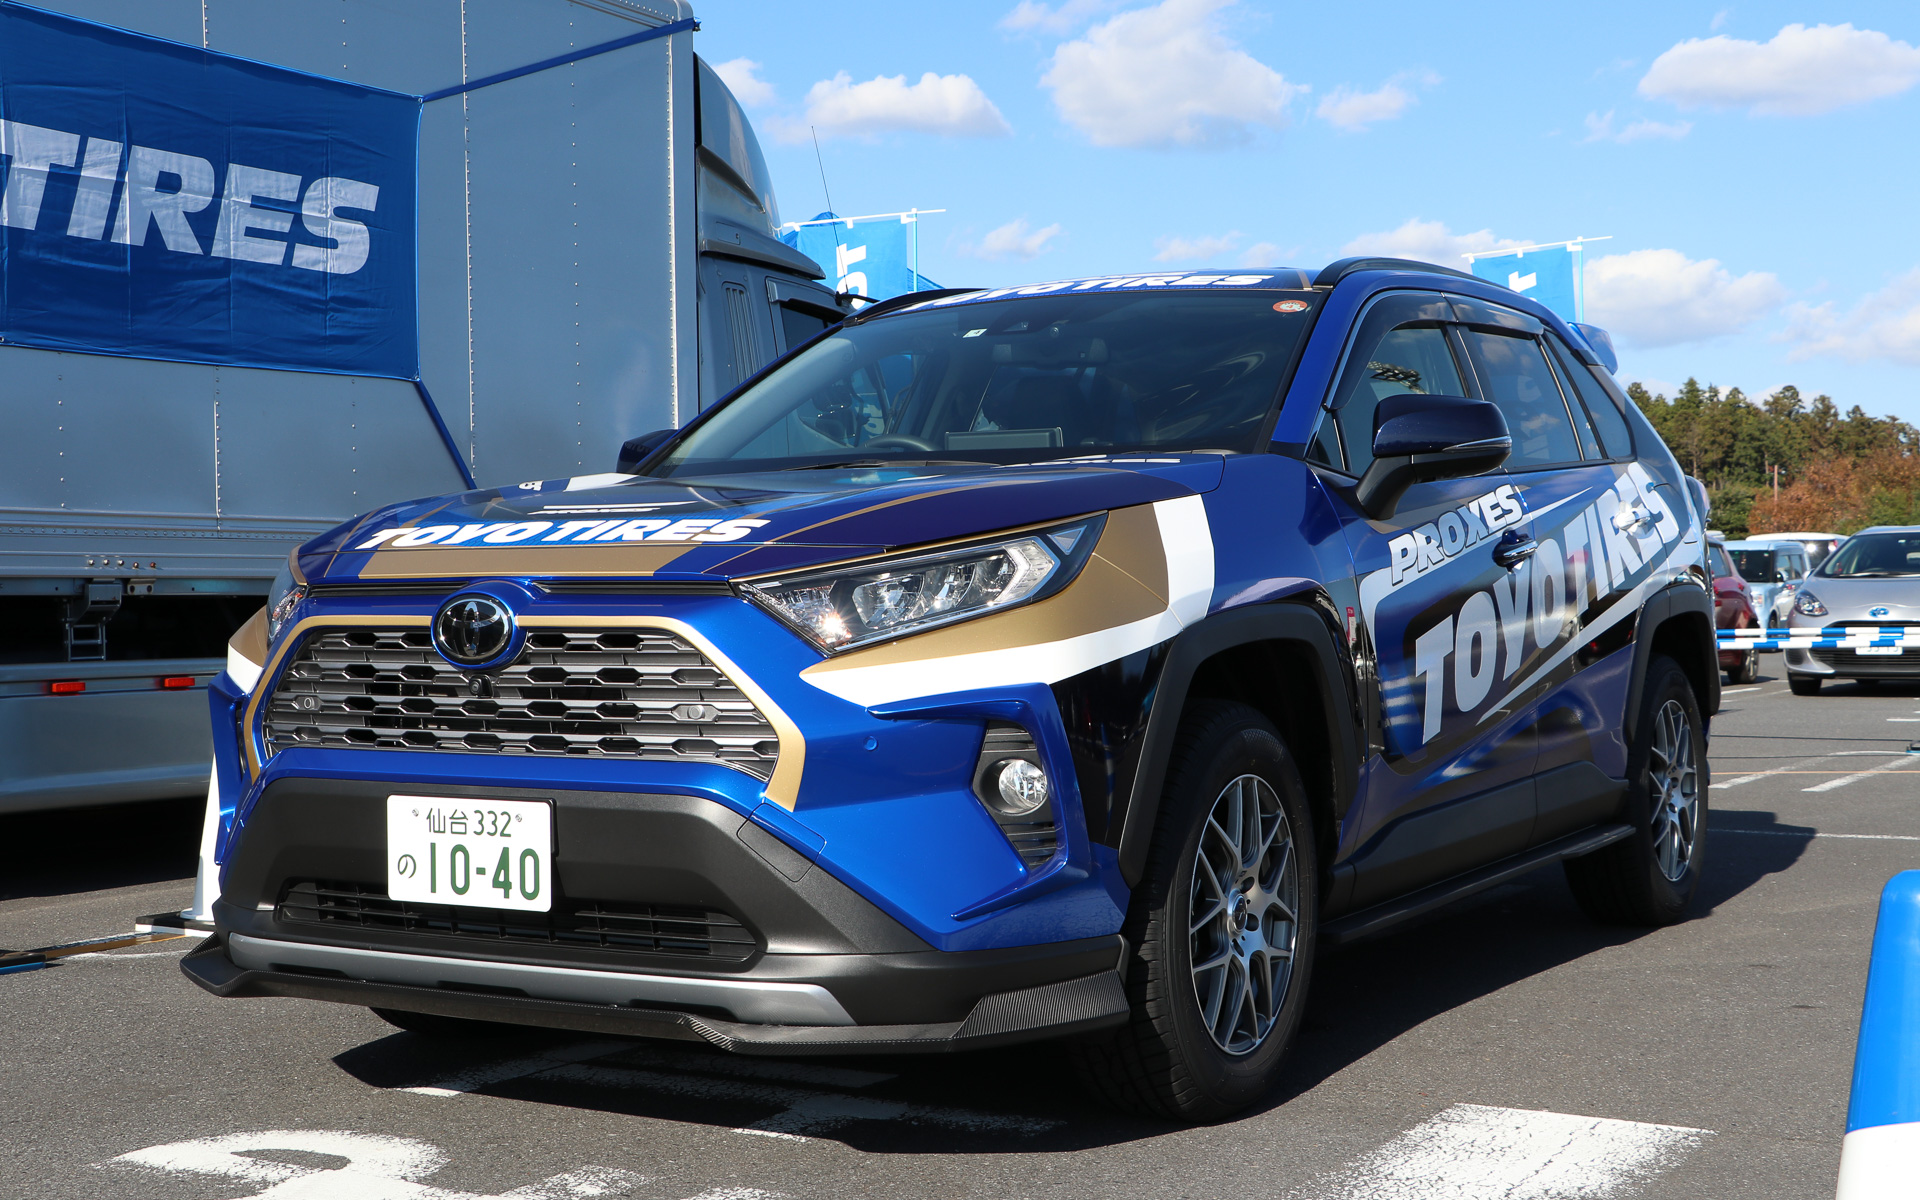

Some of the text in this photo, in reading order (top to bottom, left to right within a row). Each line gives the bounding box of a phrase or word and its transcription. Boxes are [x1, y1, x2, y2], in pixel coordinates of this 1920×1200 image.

[0, 118, 379, 275] TIRES
[1388, 484, 1524, 586] PROXES
[430, 842, 540, 901] 10-40
